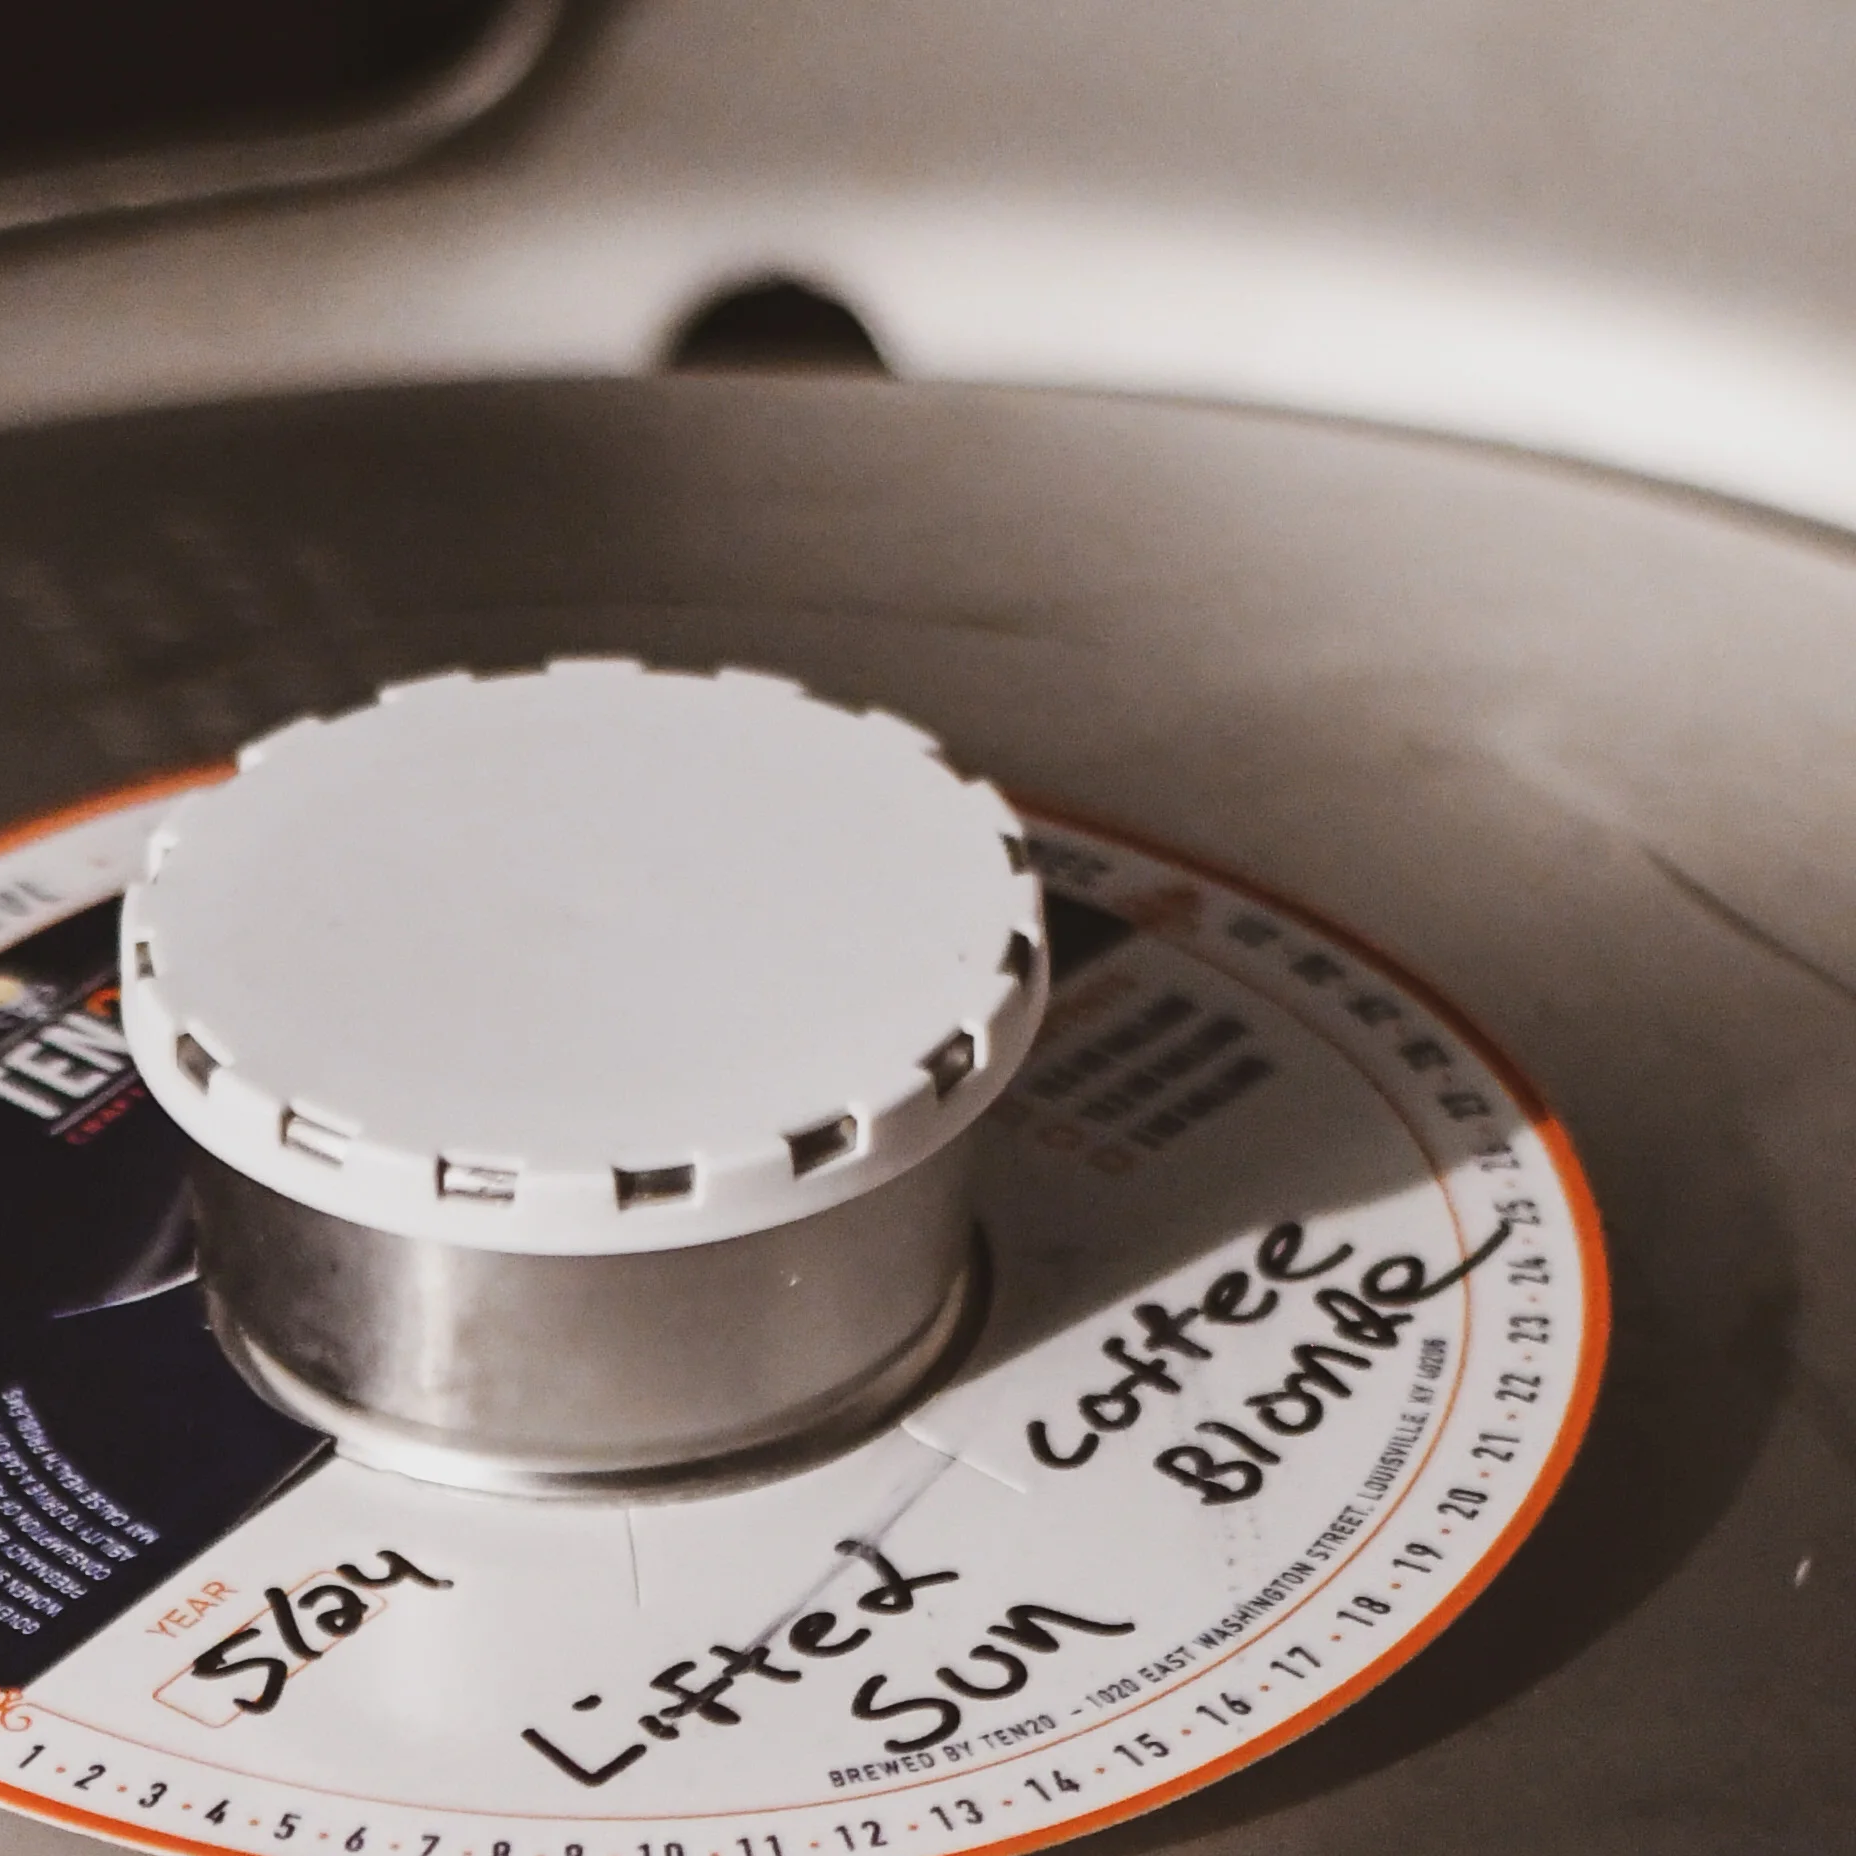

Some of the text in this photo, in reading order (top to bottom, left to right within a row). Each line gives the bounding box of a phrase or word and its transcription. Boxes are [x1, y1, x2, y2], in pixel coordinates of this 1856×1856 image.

[1494, 1199, 1541, 1231] 25
[1508, 1255, 1551, 1285] 24
[1507, 1314, 1552, 1344] 23
[1153, 1220, 1511, 1506] Blonde
[1494, 1372, 1543, 1404] 22
[1470, 1432, 1521, 1463] 21
[1436, 1487, 1489, 1521] 20
[1392, 1542, 1443, 1573] 19
[145, 1580, 238, 1640] YEAR
[1336, 1595, 1392, 1627] 18
[190, 1549, 455, 1715] 5/24
[521, 1538, 960, 1787] Lifted
[828, 1748, 936, 1788] BREWED
[941, 1740, 973, 1762] BY
[978, 1714, 1057, 1748] TEN20
[1085, 1677, 1141, 1707] 1020
[1137, 1645, 1196, 1683] EAST
[1197, 1561, 1317, 1649] WASHINGTON
[1269, 1645, 1322, 1679] 17
[851, 1603, 1136, 1755] Sun
[1195, 1692, 1253, 1726] 16
[18, 1744, 46, 1769] 1
[1113, 1732, 1170, 1767] 15
[73, 1763, 107, 1790] 2
[1023, 1769, 1081, 1802] 14
[137, 1781, 168, 1808] 3
[204, 1799, 230, 1825] 4
[273, 1812, 301, 1841] 5
[929, 1798, 984, 1831] 13
[344, 1826, 367, 1853] 6
[834, 1819, 888, 1851] 12
